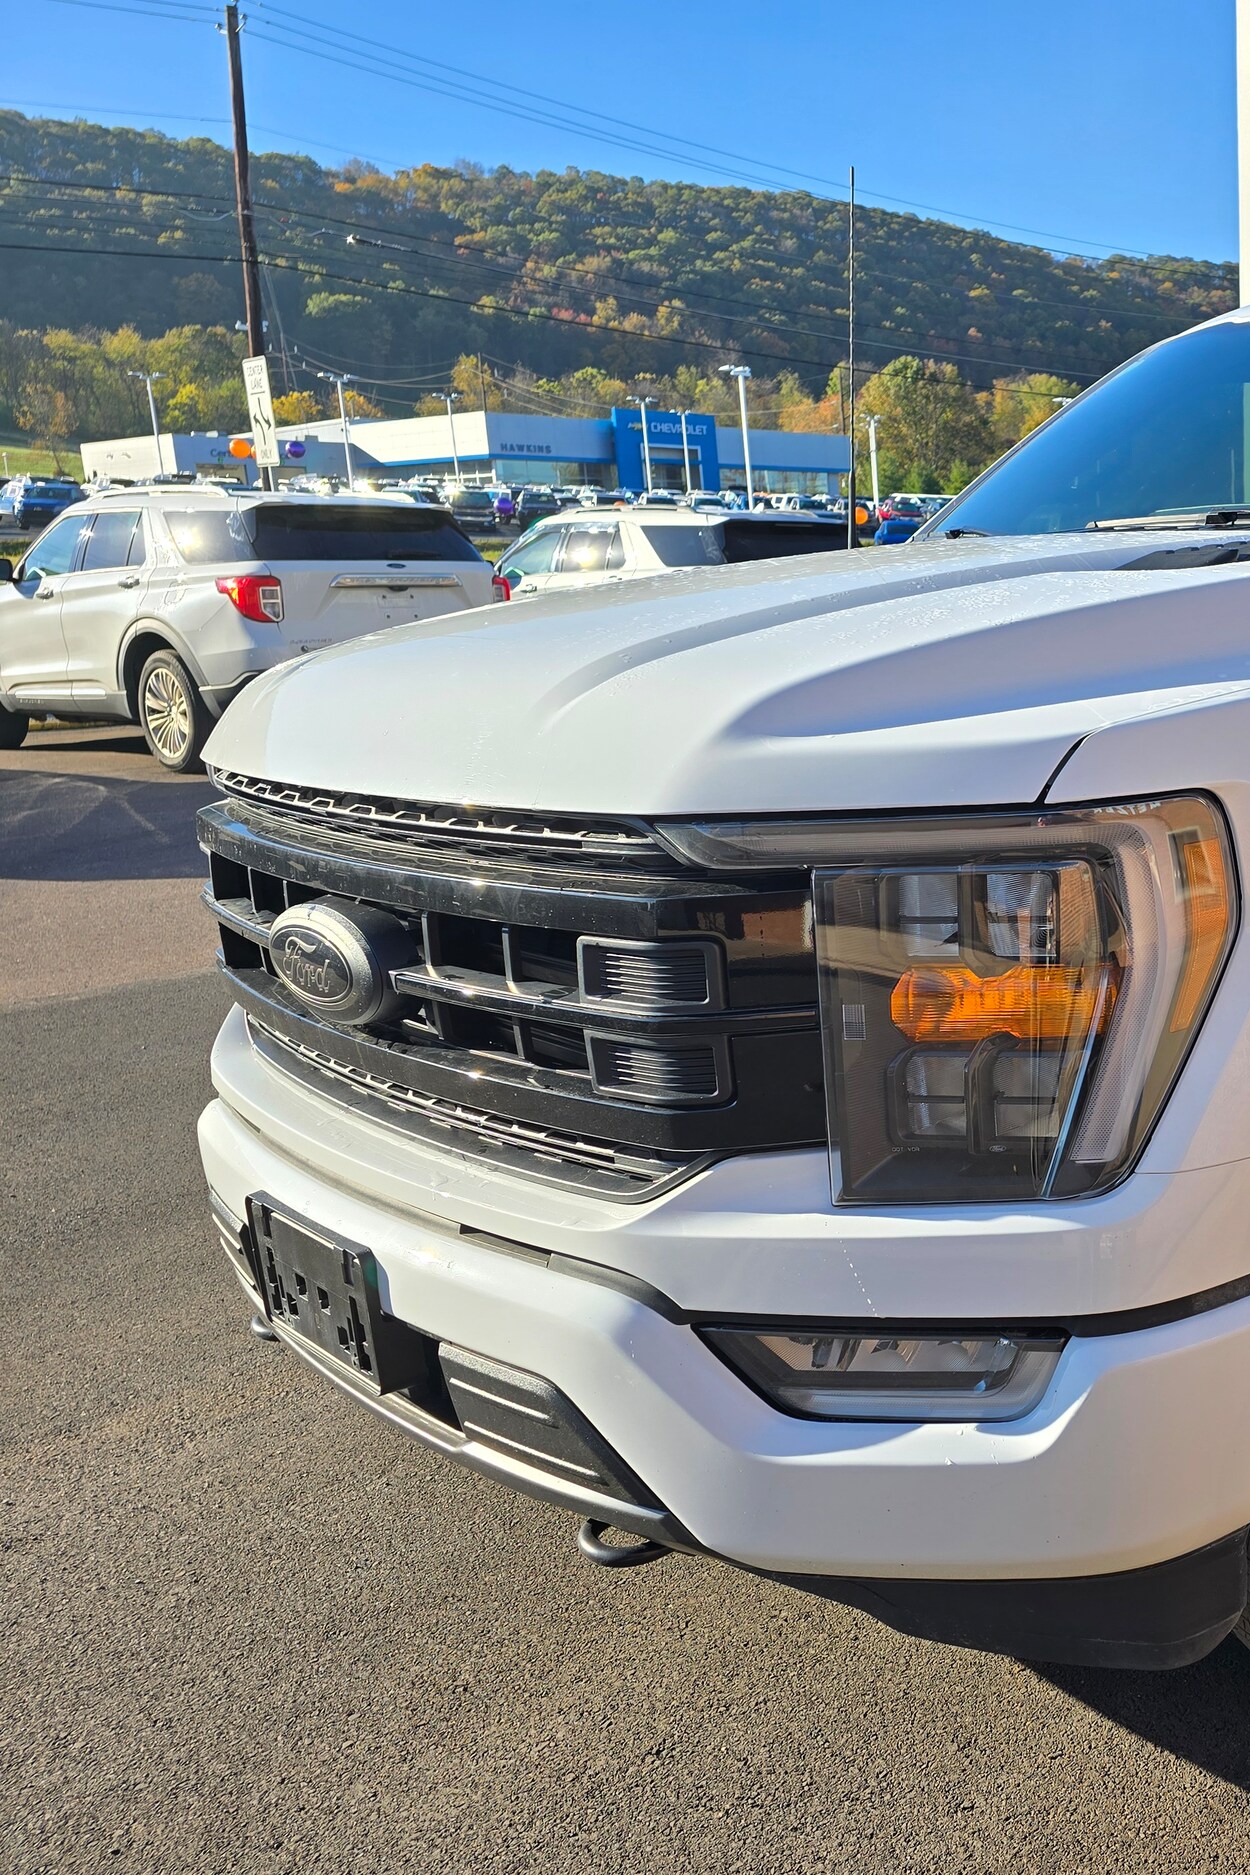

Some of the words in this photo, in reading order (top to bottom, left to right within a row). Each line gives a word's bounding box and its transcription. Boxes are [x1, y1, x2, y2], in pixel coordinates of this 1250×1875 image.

[250, 377, 263, 390] LANE
[650, 422, 707, 435] CHEVROLET
[500, 442, 552, 454] HAWKINS
[282, 936, 332, 994] Ford
